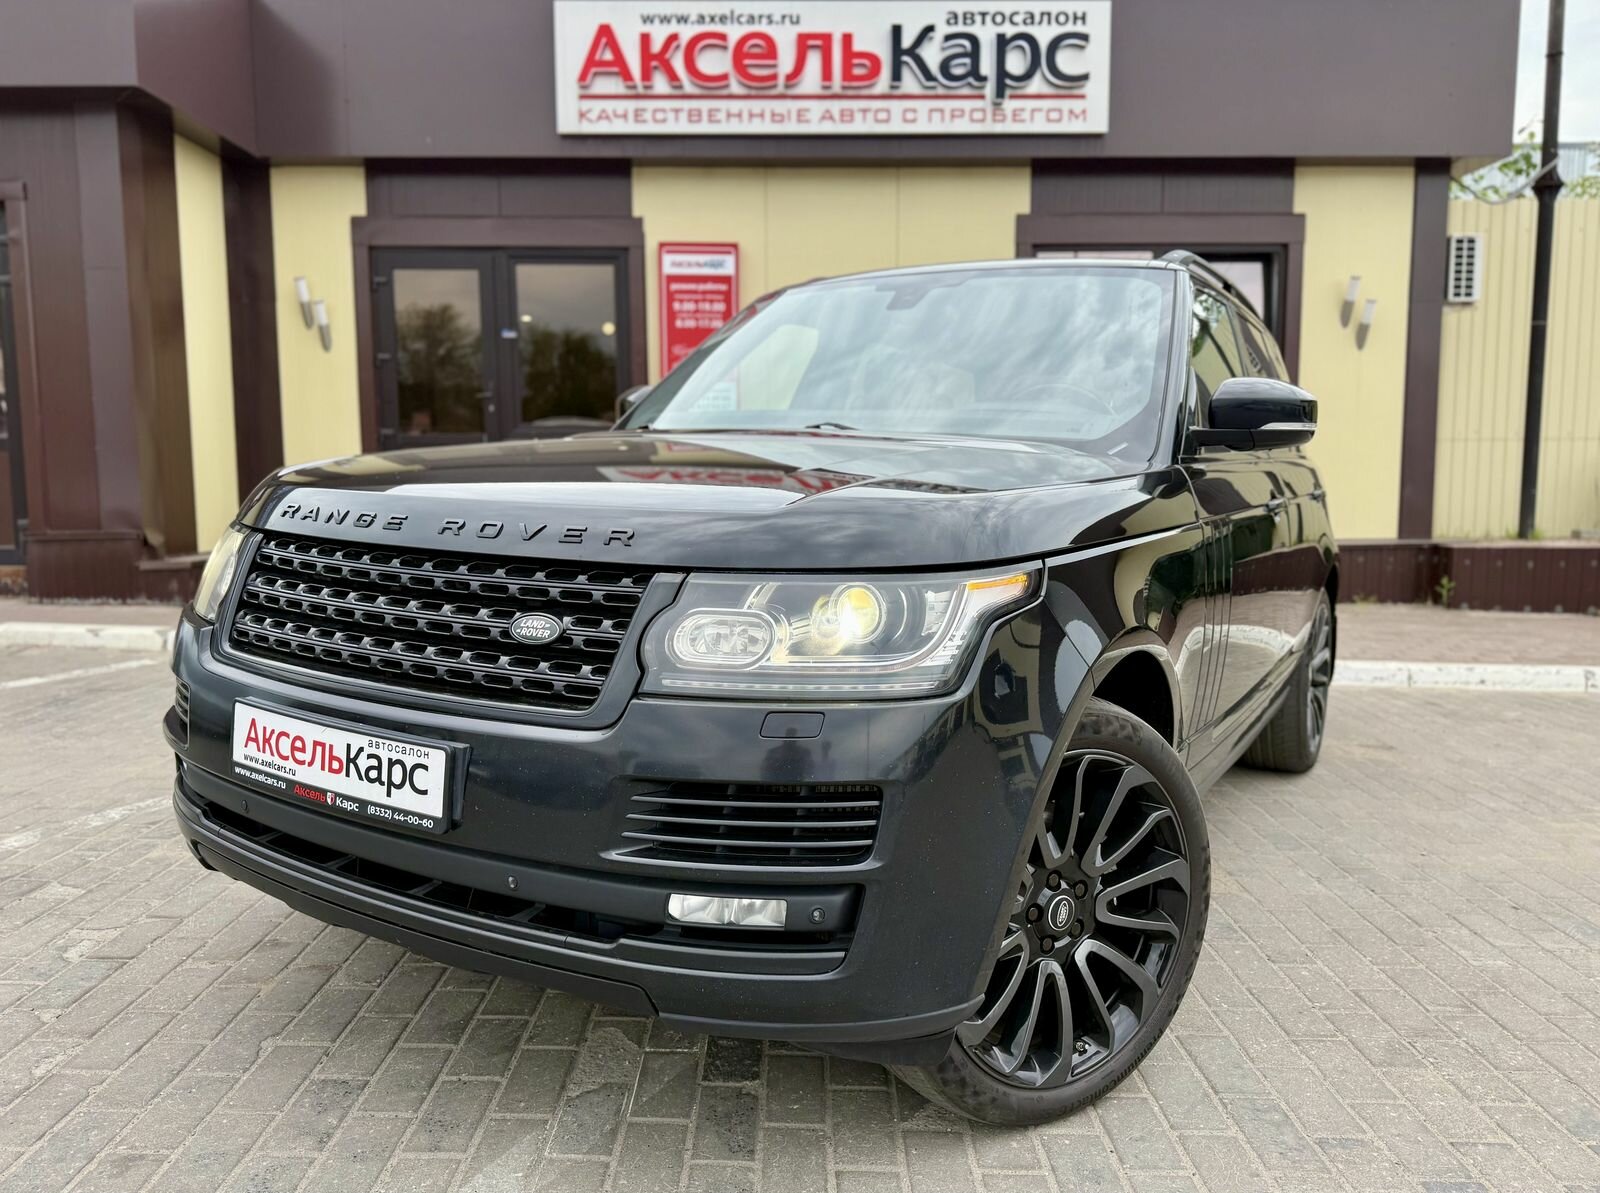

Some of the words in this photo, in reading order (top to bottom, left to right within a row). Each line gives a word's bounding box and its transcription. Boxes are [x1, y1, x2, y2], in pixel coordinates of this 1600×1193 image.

[640, 10, 800, 25] www.axelcars.ru
[946, 11, 1087, 26] автосалон
[577, 22, 1091, 105] АксельКарс
[578, 107, 811, 124] КАЧЕСТВЕННЫЕ
[818, 107, 892, 123] АВТО
[902, 108, 918, 123] С
[928, 108, 1087, 123] ПРОБЕГОМ
[279, 503, 409, 531] RANGE
[437, 518, 636, 546] ROVER
[520, 619, 546, 629] LAND
[520, 627, 551, 638] ROVER
[244, 718, 430, 797] АксельКарс
[367, 739, 430, 759] автосалон
[243, 753, 297, 776] www.axelcars.ru
[234, 766, 286, 789] www.axelcars.ru
[293, 784, 326, 803] Аксель
[336, 797, 359, 811] Карс
[367, 805, 392, 819] (8332)
[393, 812, 434, 828] 44-00-60
